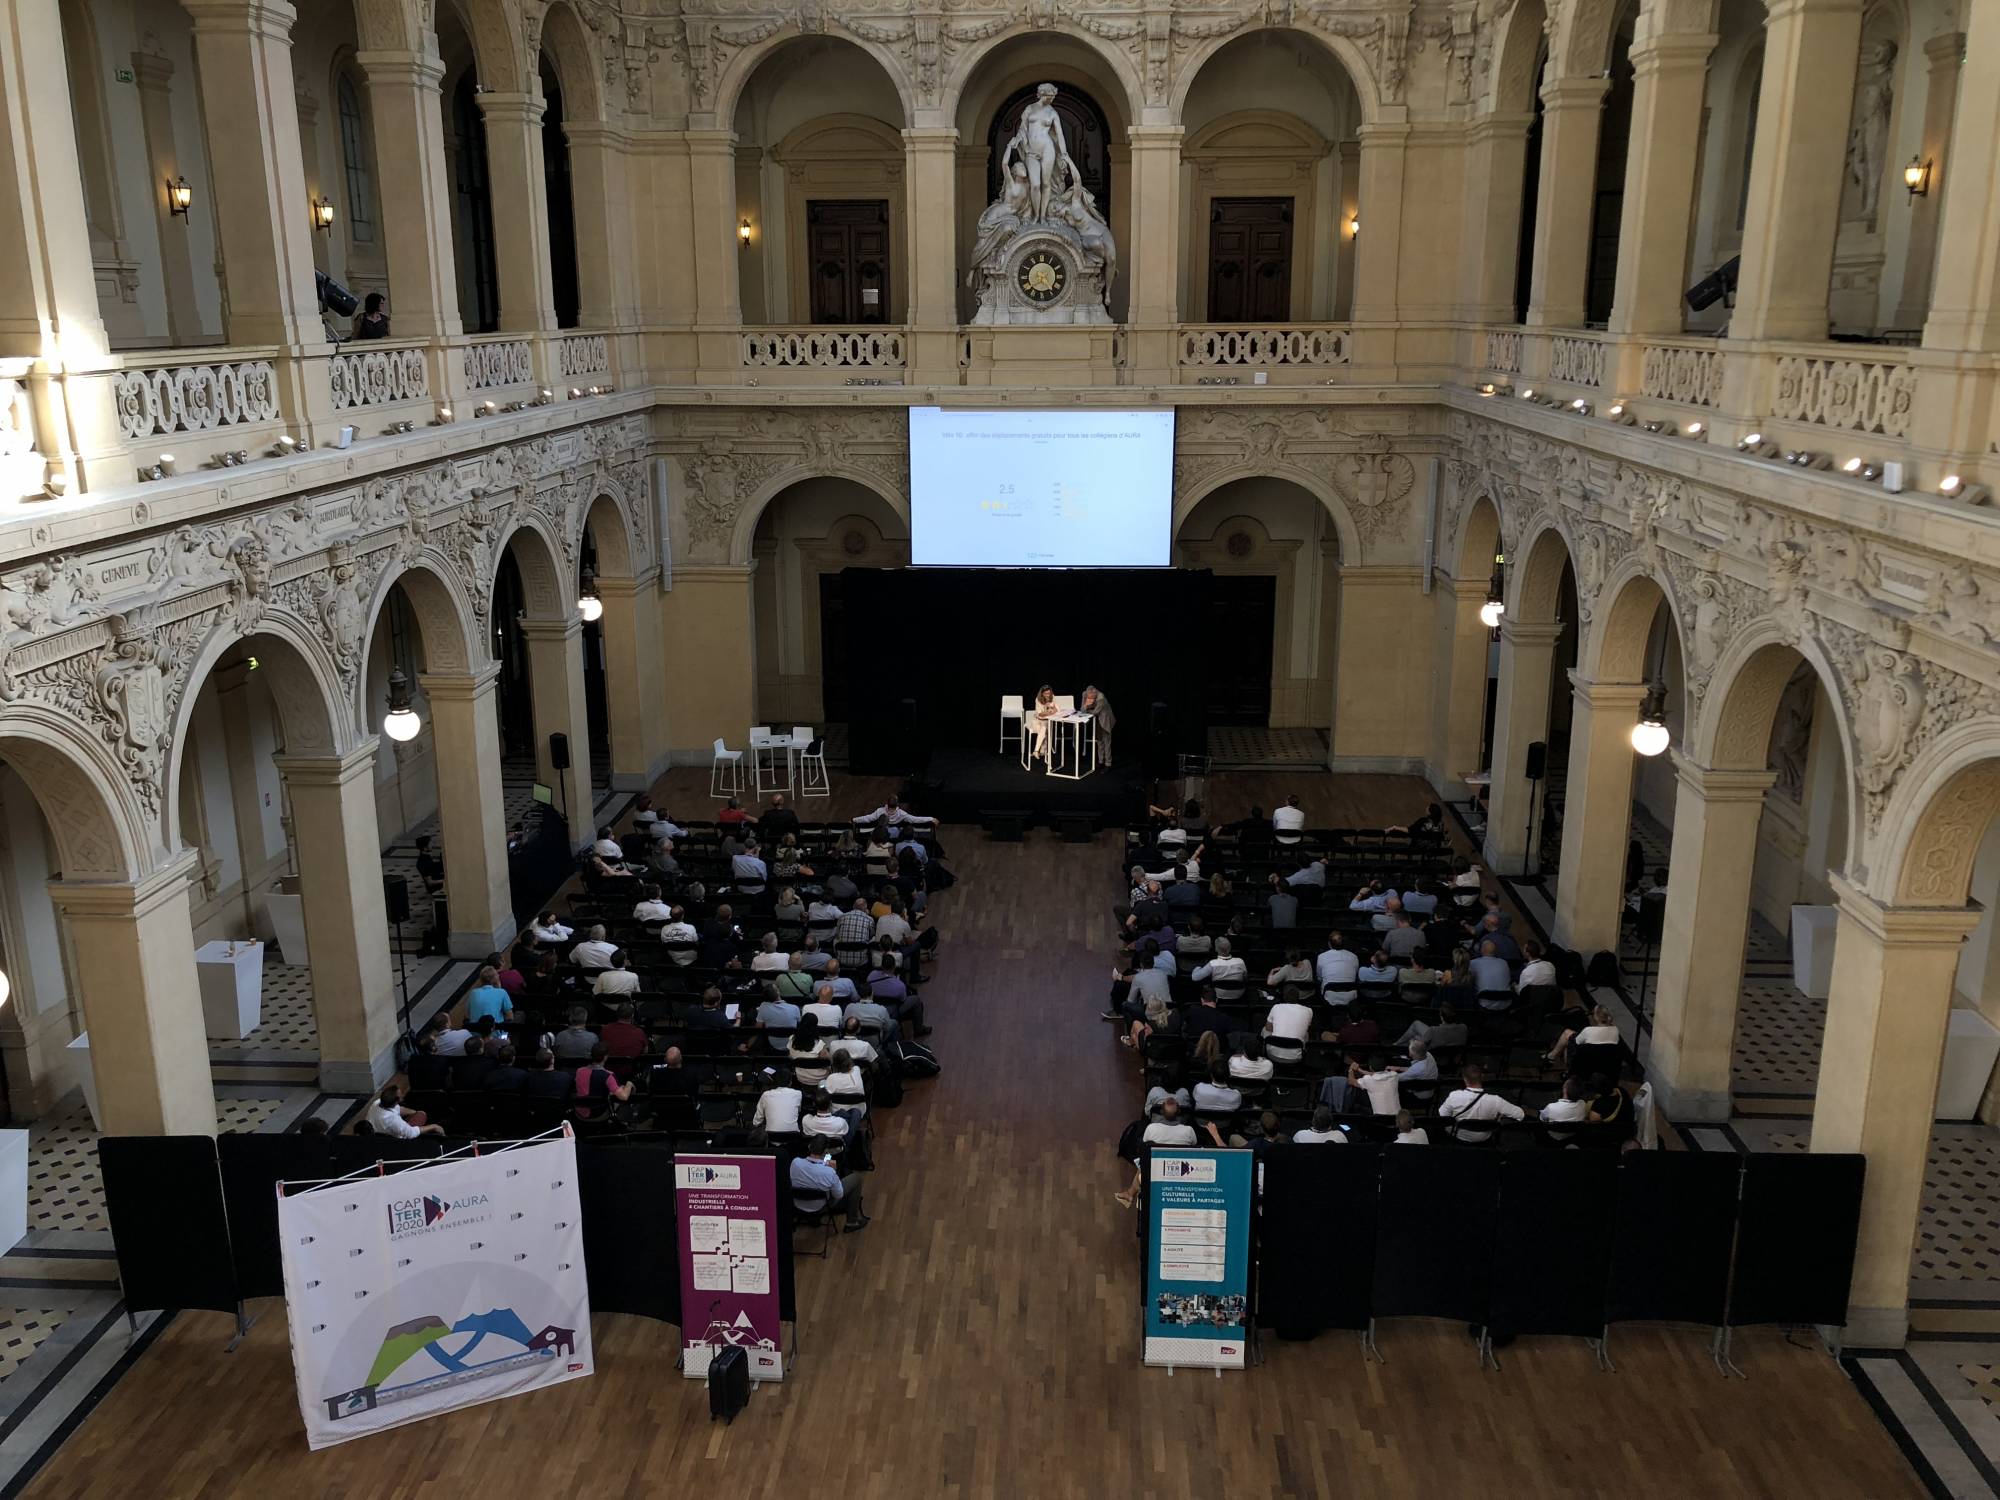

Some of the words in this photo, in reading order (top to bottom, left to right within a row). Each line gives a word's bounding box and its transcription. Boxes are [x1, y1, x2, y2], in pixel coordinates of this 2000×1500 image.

[393, 1197, 421, 1212] CAP
[452, 1194, 489, 1210] AURA
[395, 1208, 422, 1222] TER
[391, 1226, 436, 1242] GAGNONS
[440, 1215, 485, 1230] ENSEMBLE
[396, 1218, 424, 1233] 2020
